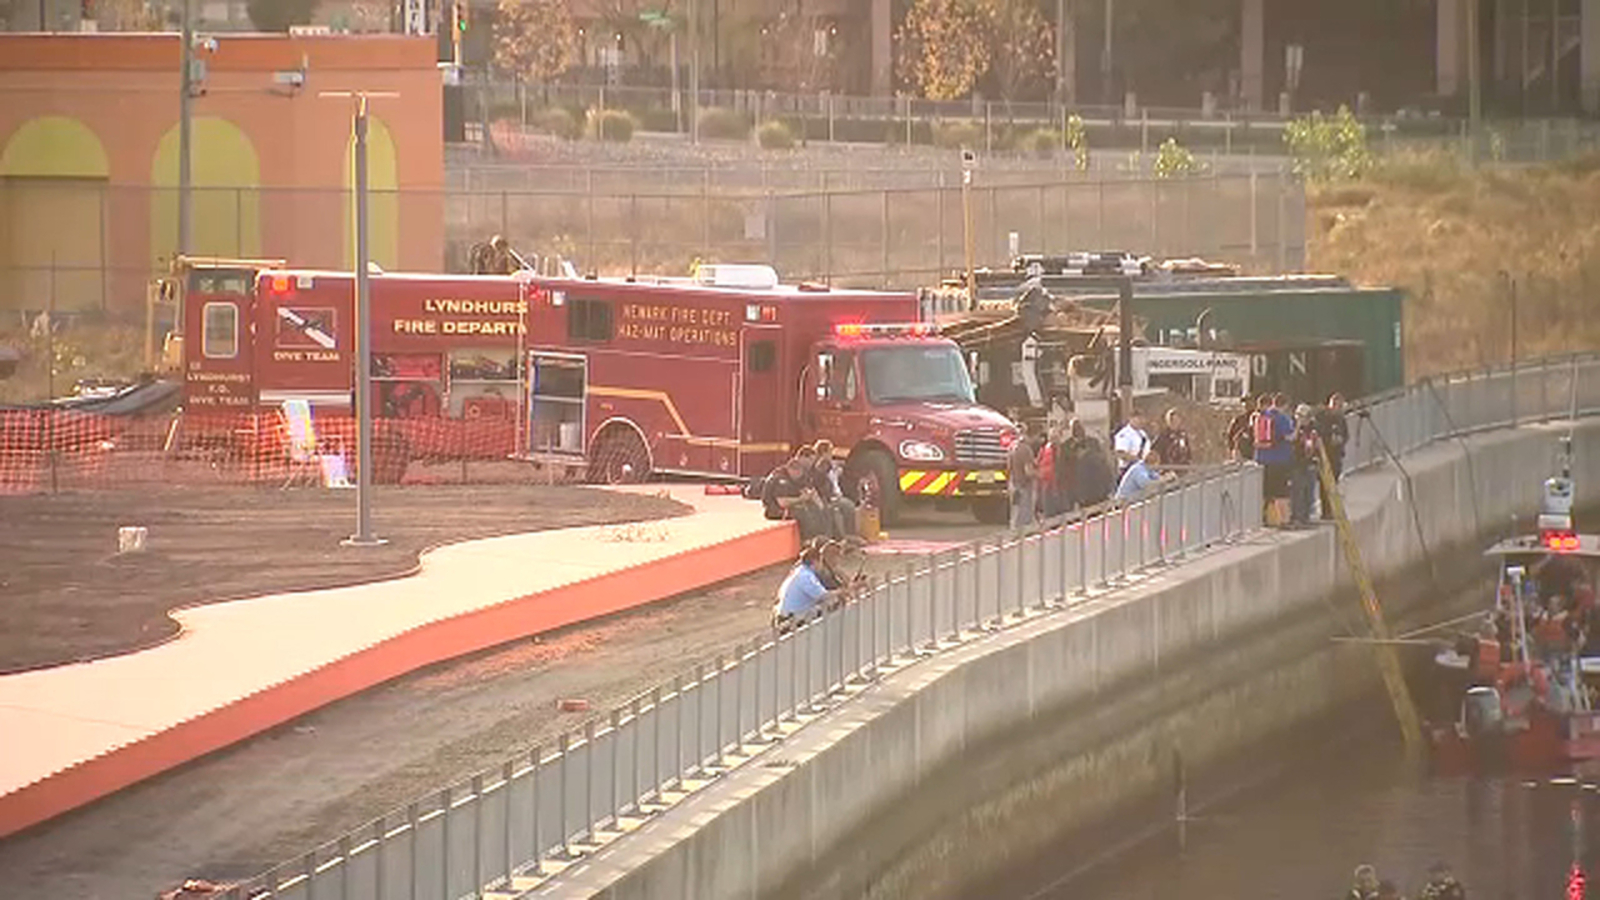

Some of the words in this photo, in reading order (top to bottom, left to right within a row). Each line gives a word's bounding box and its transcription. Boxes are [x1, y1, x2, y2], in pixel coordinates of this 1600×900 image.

[622, 304, 668, 321] NEWARK
[671, 306, 697, 324] FIRE
[394, 319, 437, 333] FIRE
[618, 324, 666, 339] HAZ-MAT
[669, 326, 737, 347] OPERATIONS
[274, 351, 302, 362] DIVE
[305, 351, 341, 362] TEAM
[189, 395, 216, 406] DIVE
[219, 395, 250, 406] TEAM
